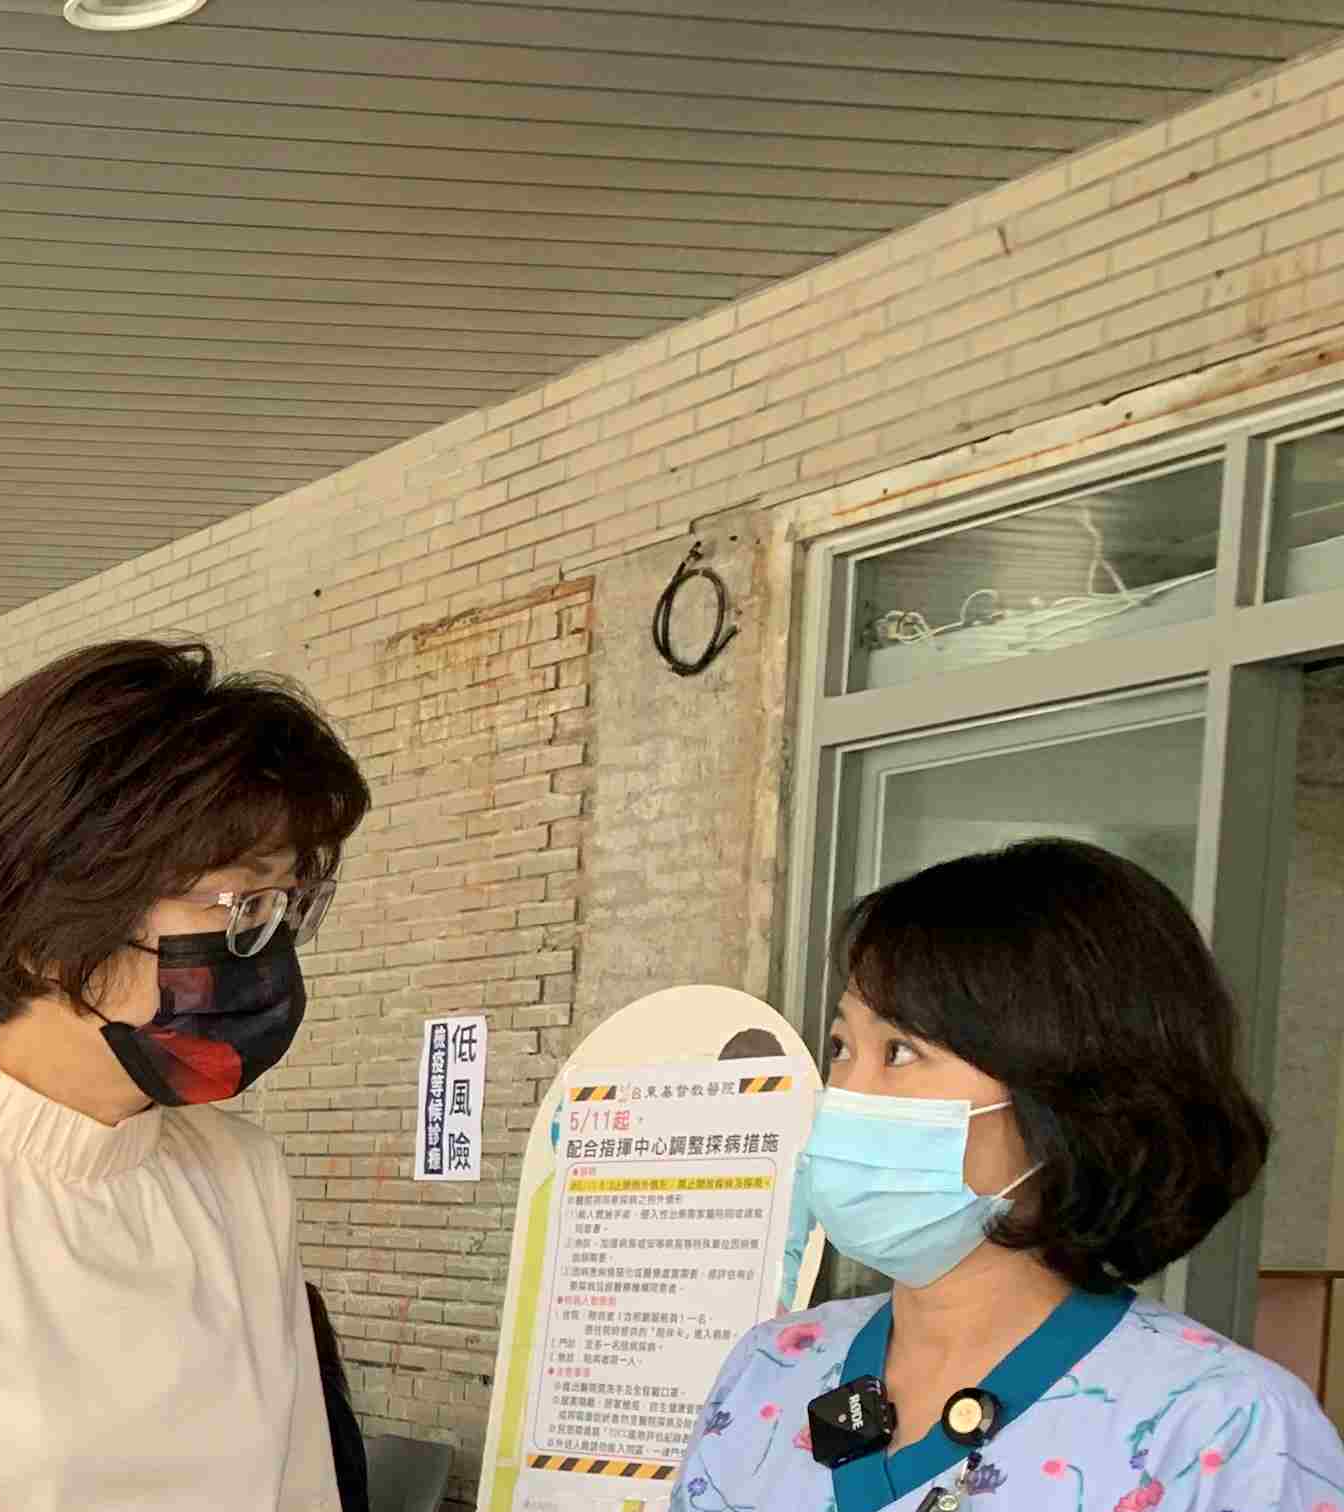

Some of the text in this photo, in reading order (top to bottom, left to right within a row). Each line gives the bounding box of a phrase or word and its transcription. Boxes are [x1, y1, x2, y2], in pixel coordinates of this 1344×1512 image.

[448, 1023, 478, 1171] 低風險
[566, 1132, 781, 1159] 配合指揮中心調整探病措施
